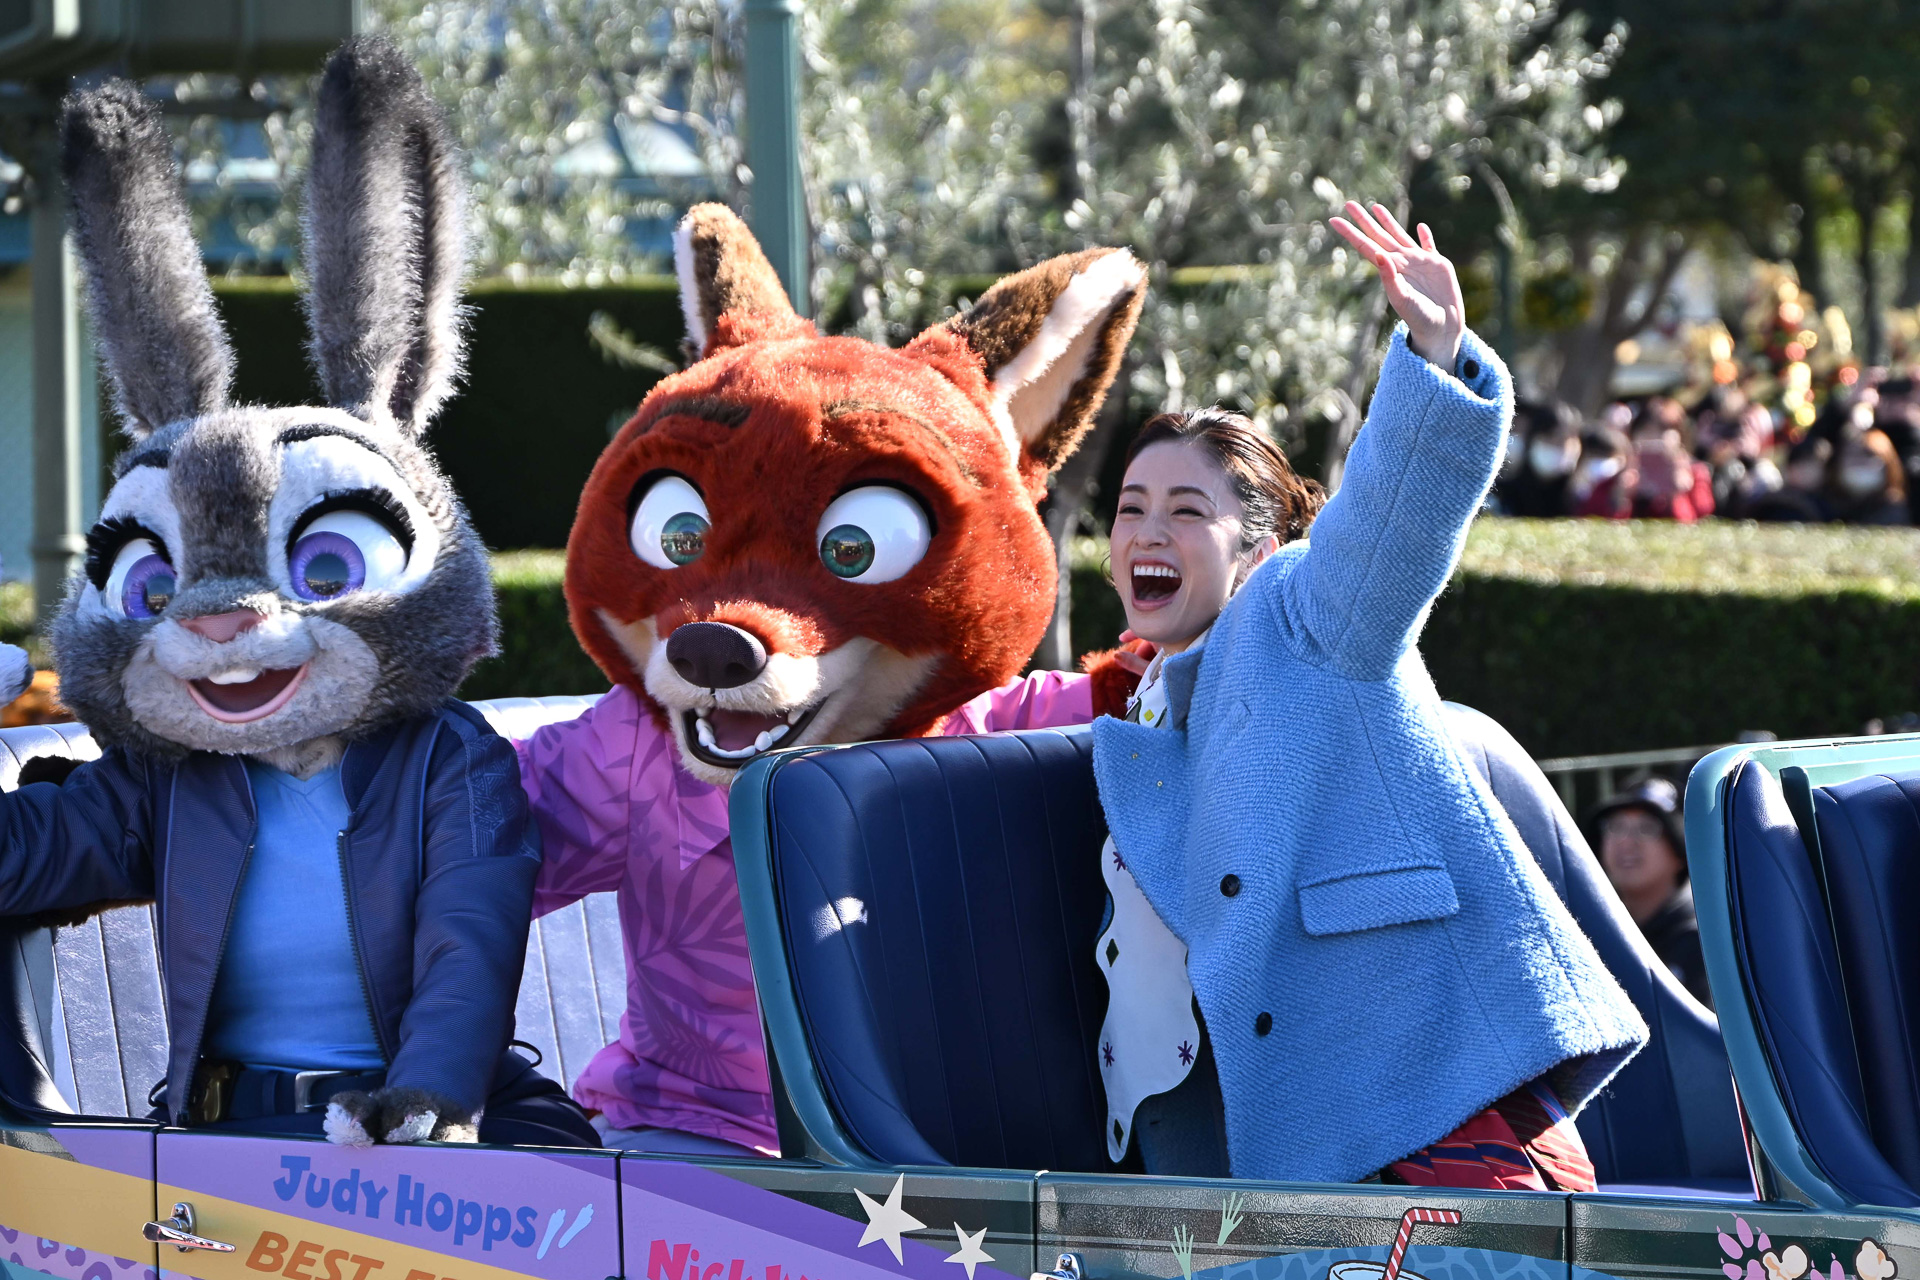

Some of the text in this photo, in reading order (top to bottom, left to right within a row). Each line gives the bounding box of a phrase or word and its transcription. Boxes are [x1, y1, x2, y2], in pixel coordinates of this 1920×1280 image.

[273, 1155, 538, 1251] Judy Hopps
[245, 1230, 385, 1280] BEST
